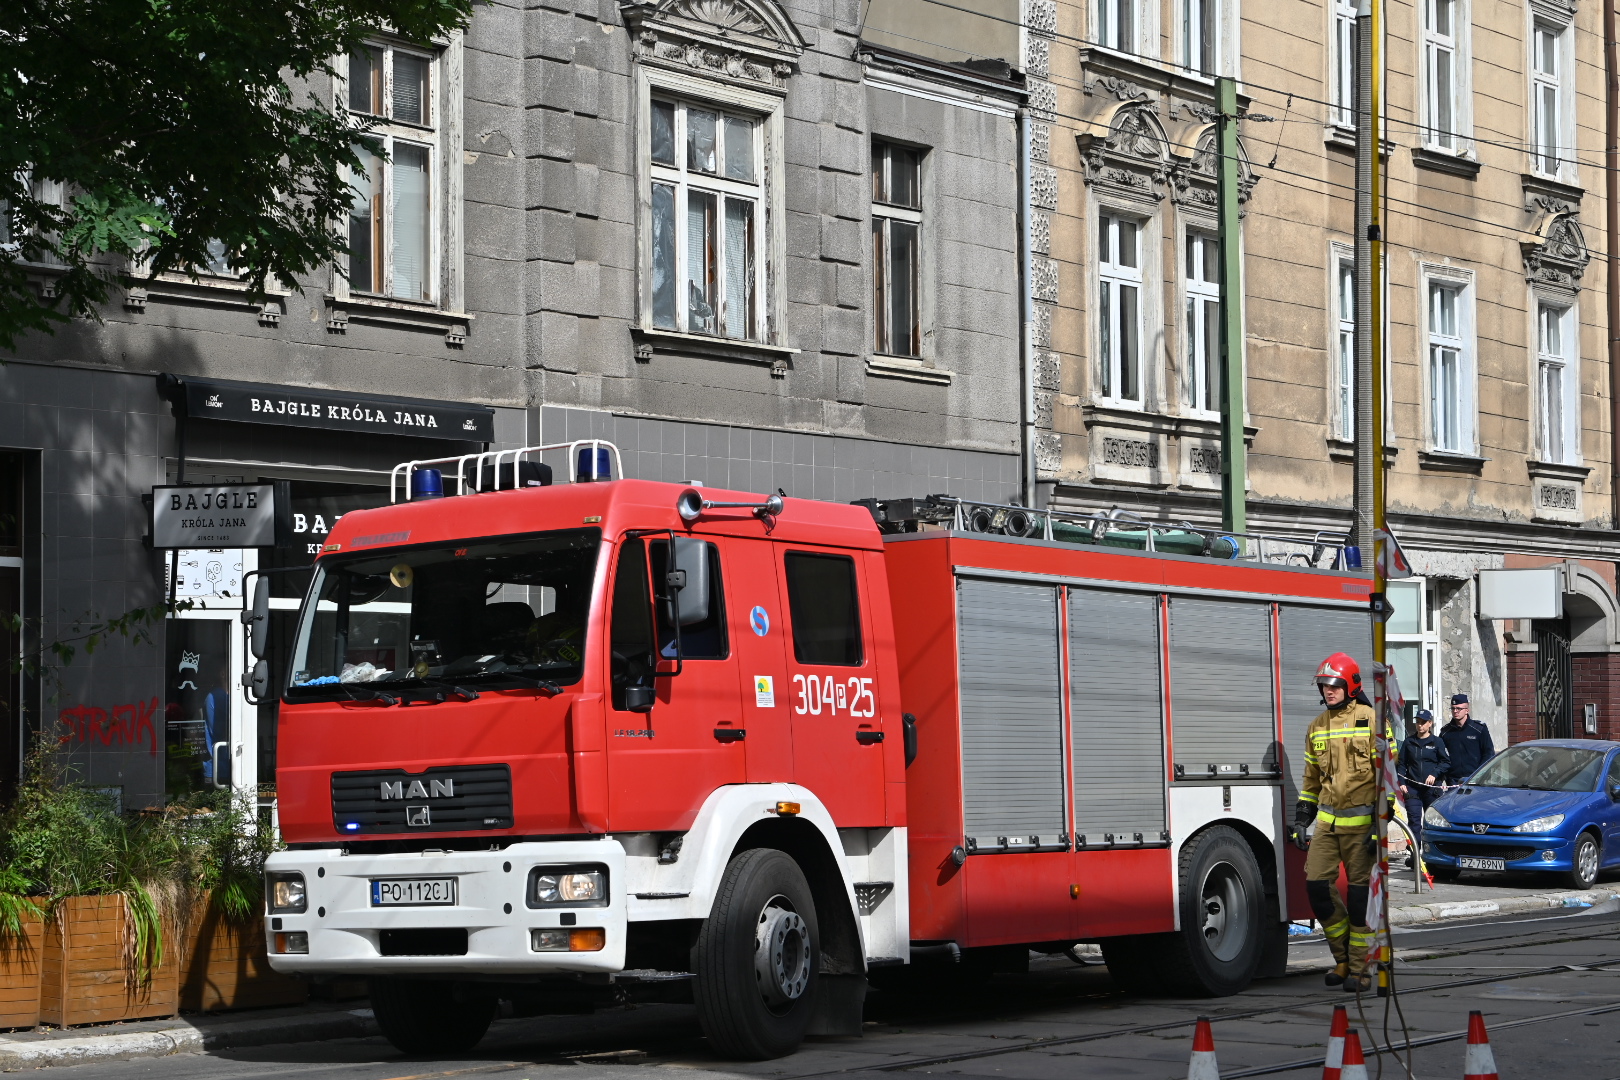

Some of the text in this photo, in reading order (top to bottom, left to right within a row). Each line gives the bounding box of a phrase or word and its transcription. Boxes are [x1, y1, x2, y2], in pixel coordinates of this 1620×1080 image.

[250, 398, 438, 428] BAJGLE KRÓLA JANA
[170, 492, 257, 510] BAJGLE
[181, 516, 246, 528] KRÓLA JANA
[380, 778, 454, 800] MAN
